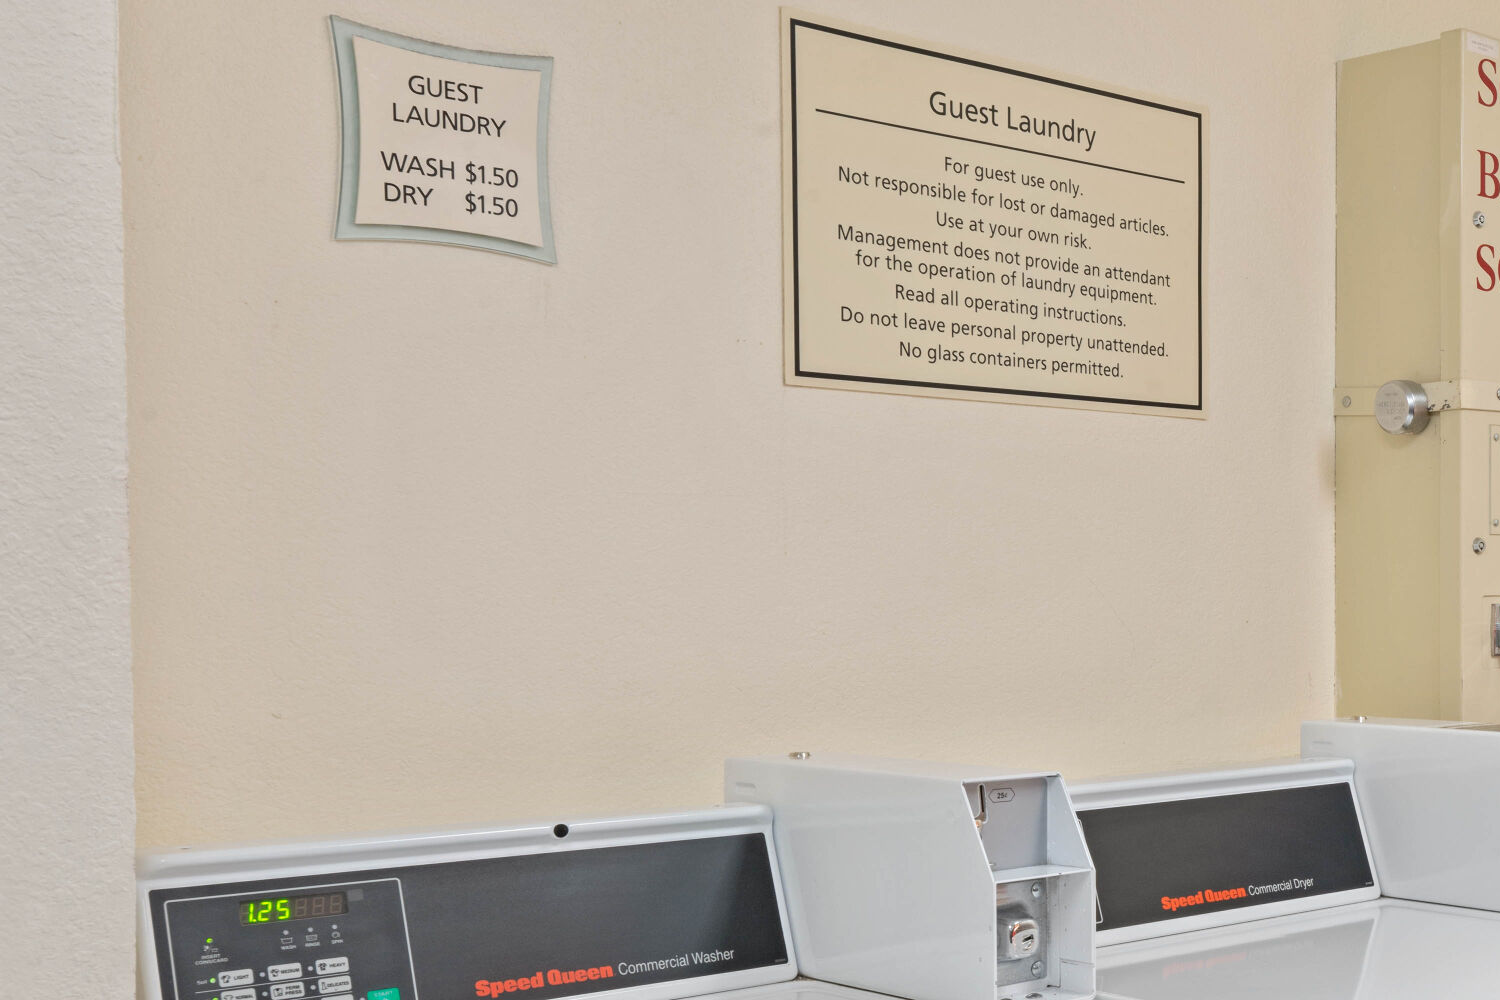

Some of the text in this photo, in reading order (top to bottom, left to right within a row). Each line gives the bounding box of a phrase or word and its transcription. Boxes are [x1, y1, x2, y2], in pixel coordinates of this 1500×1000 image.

[407, 75, 484, 105] GUEST
[392, 102, 507, 138] LAUNDRY
[929, 91, 1096, 152] Guest Laundry
[380, 150, 519, 189] WASH $1.50
[945, 156, 1083, 199] For guest use only.
[384, 182, 519, 218] DRY $1.50
[839, 166, 1169, 237] Not responsible for lost or damaged articles.
[936, 211, 1091, 250] Use at your own risk.
[838, 224, 1170, 287] Management does not provide an attendant
[855, 249, 1157, 305] for the operation of laundry equipment.
[895, 284, 1126, 327] Read all operating instructions.
[841, 306, 1168, 357] Do not leave personal property unattended.
[900, 341, 1123, 378] No glass containers permitted.
[248, 899, 290, 923] 1.25
[1161, 878, 1314, 911] Speed Queen Commercial Dryer
[475, 949, 735, 998] Speed Queen Commercial Washer
